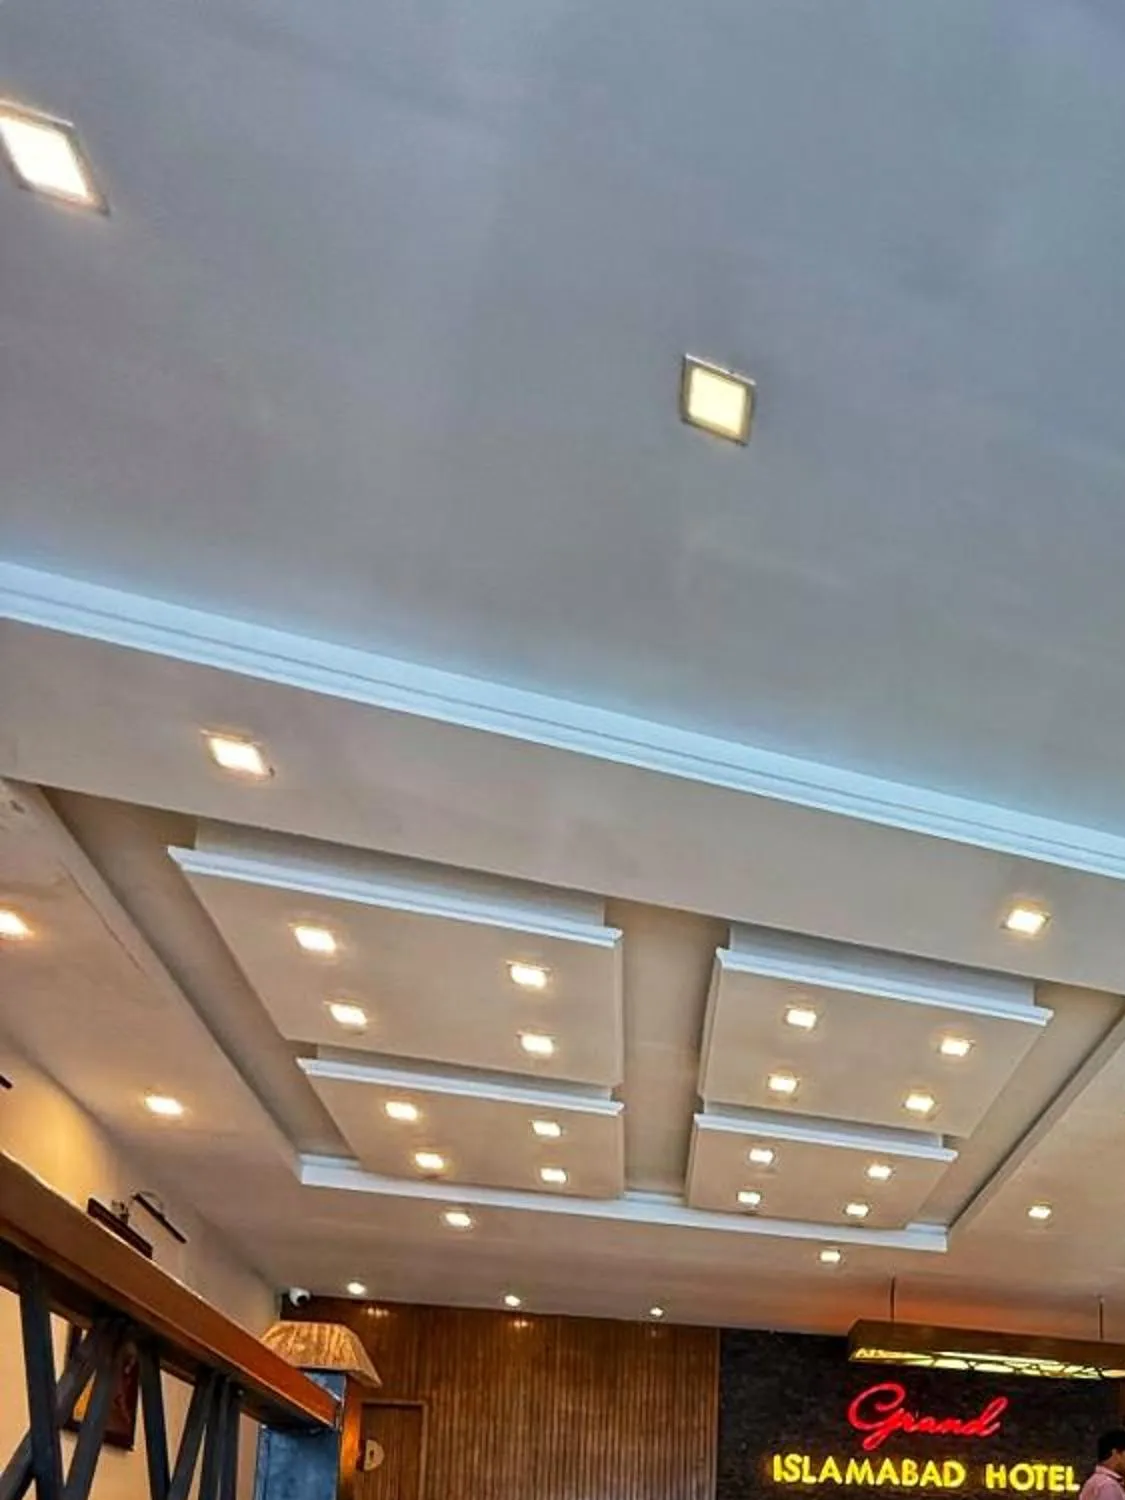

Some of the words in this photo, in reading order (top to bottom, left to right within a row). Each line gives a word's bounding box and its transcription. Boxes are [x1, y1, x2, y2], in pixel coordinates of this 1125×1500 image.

[848, 1382, 1009, 1450] Grand
[772, 1453, 967, 1488] ISLAMABAD
[985, 1462, 1081, 1492] HOTEL
